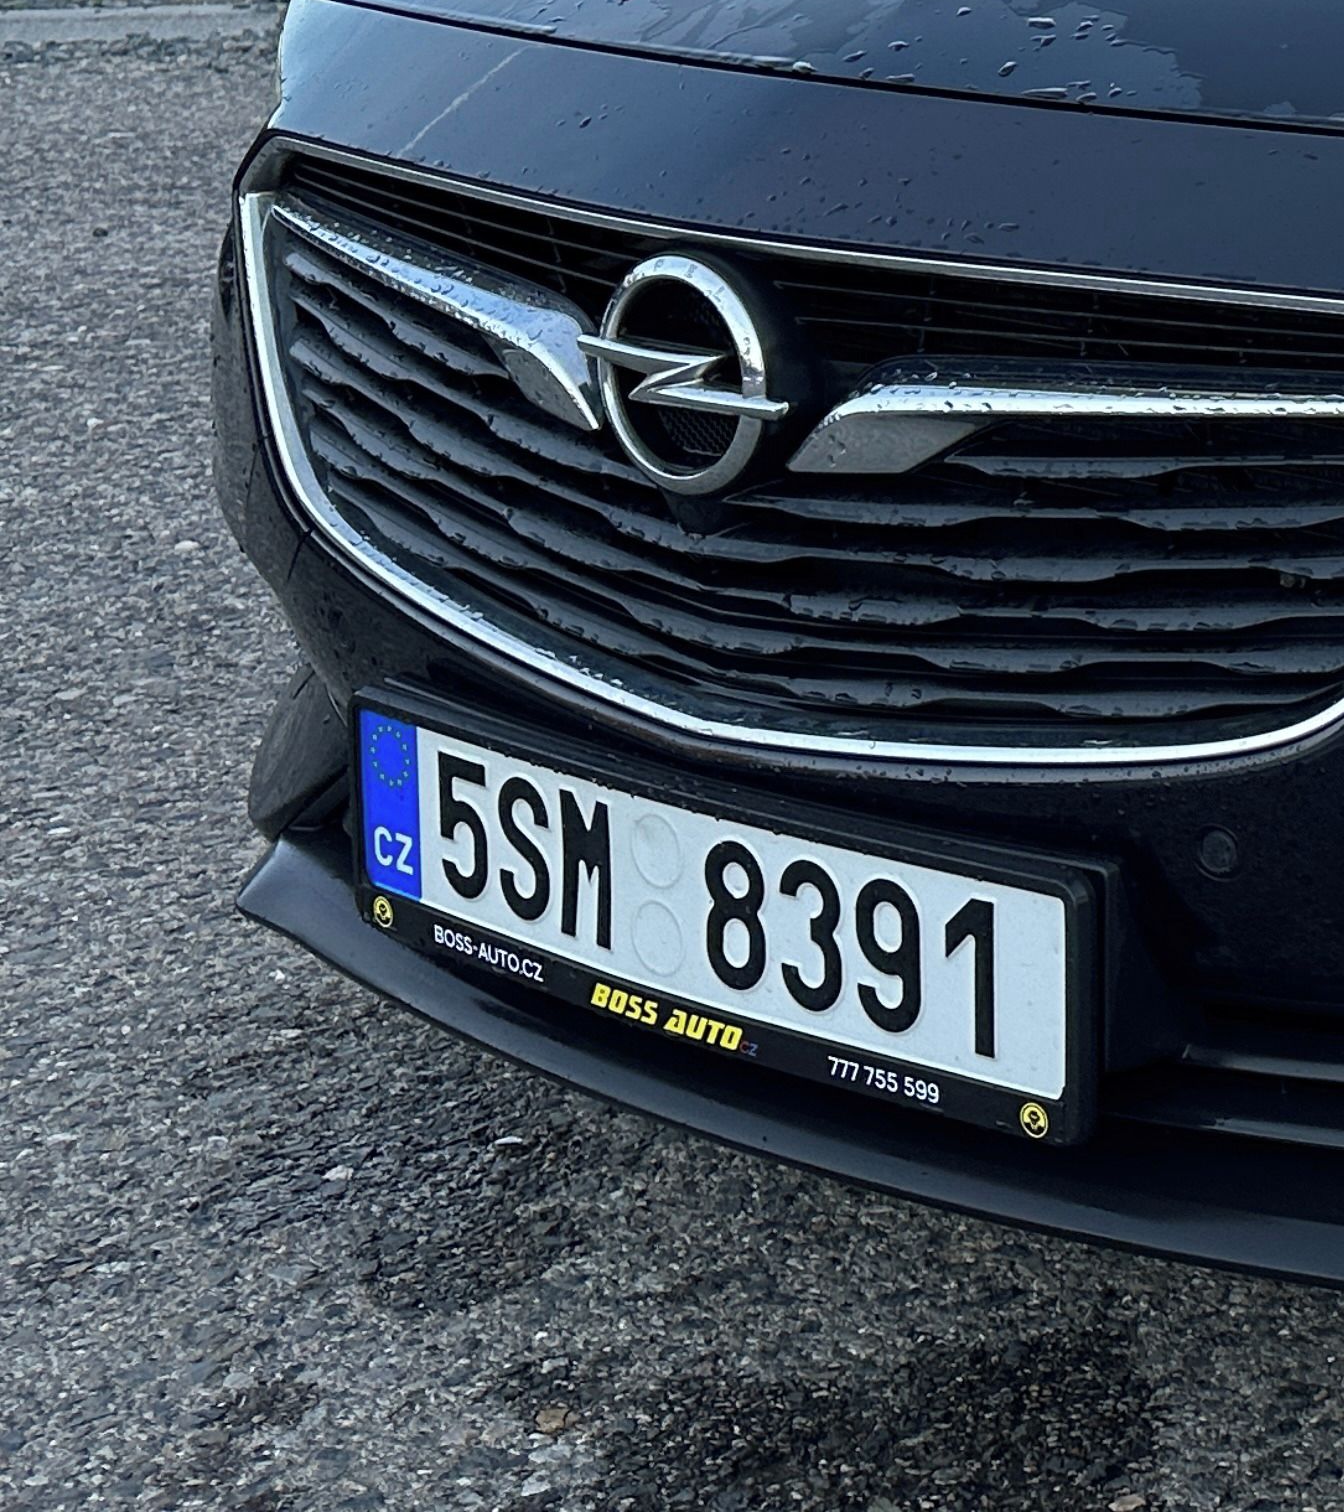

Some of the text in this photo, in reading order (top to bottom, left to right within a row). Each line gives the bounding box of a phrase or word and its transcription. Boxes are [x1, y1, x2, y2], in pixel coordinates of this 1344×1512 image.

[374, 826, 413, 875] CZ
[437, 751, 996, 1059] 5SM 8391
[433, 924, 544, 982] BOSS-AUTO.CZ
[590, 983, 658, 1025] BOSS
[663, 1008, 743, 1051] AUTO
[827, 1055, 939, 1103] 777 755 599
